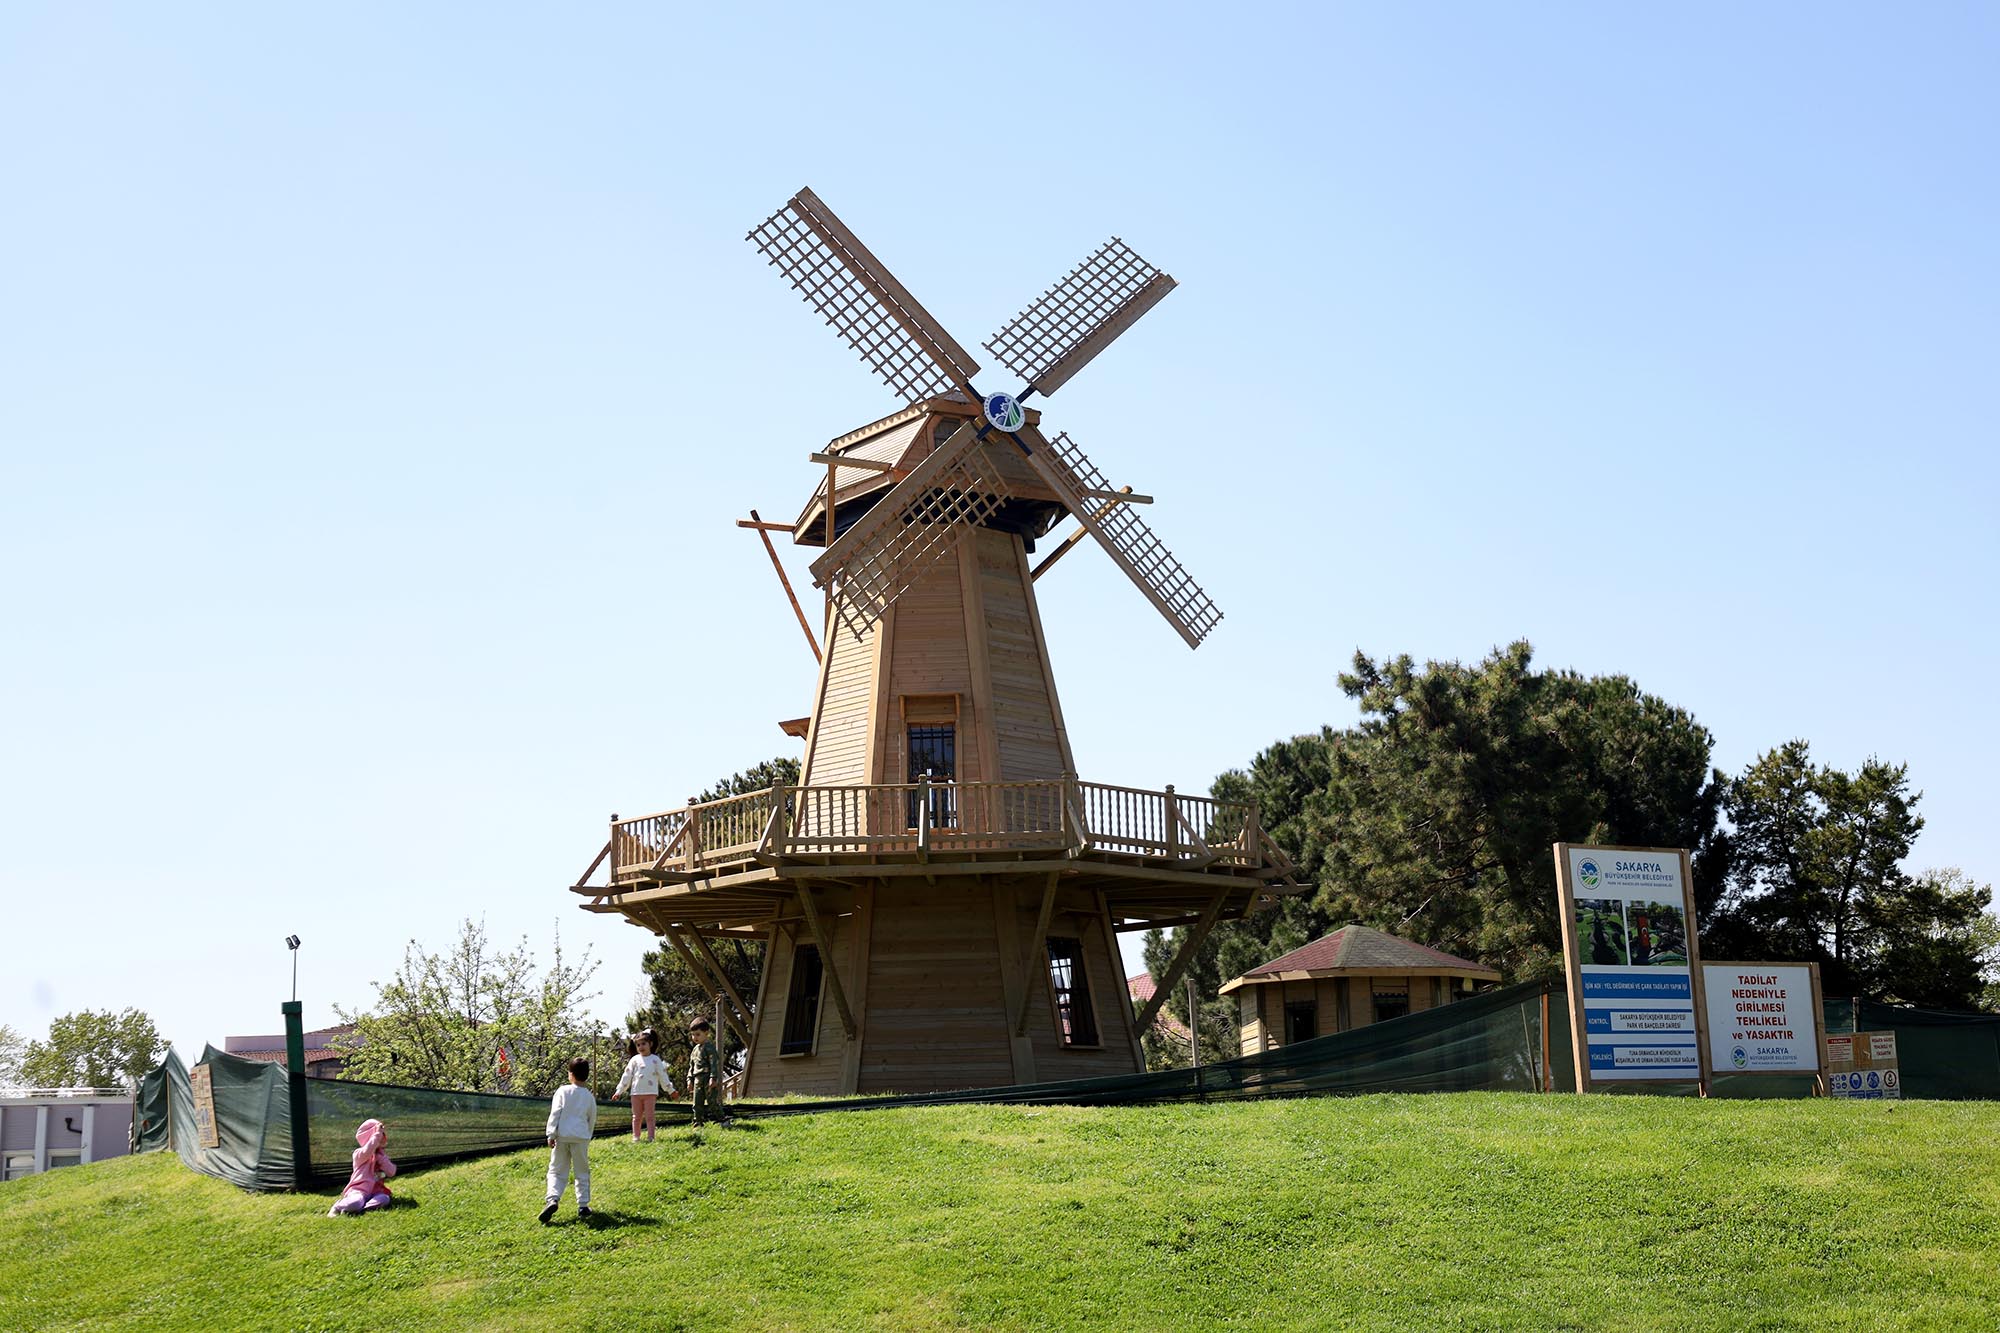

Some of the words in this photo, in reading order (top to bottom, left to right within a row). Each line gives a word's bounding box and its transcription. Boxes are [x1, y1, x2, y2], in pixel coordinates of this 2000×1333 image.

[1616, 861, 1662, 872] SAKARYA
[1642, 873, 1674, 881] BELEDİYESİ
[1738, 974, 1777, 985] TADİLAT
[1732, 988, 1786, 998] NEDENİYLE
[1736, 1001, 1785, 1012] GİRİLMESİ
[1736, 1015, 1786, 1026] TEHLİKELİ
[1745, 1030, 1793, 1040] YASAKTIR
